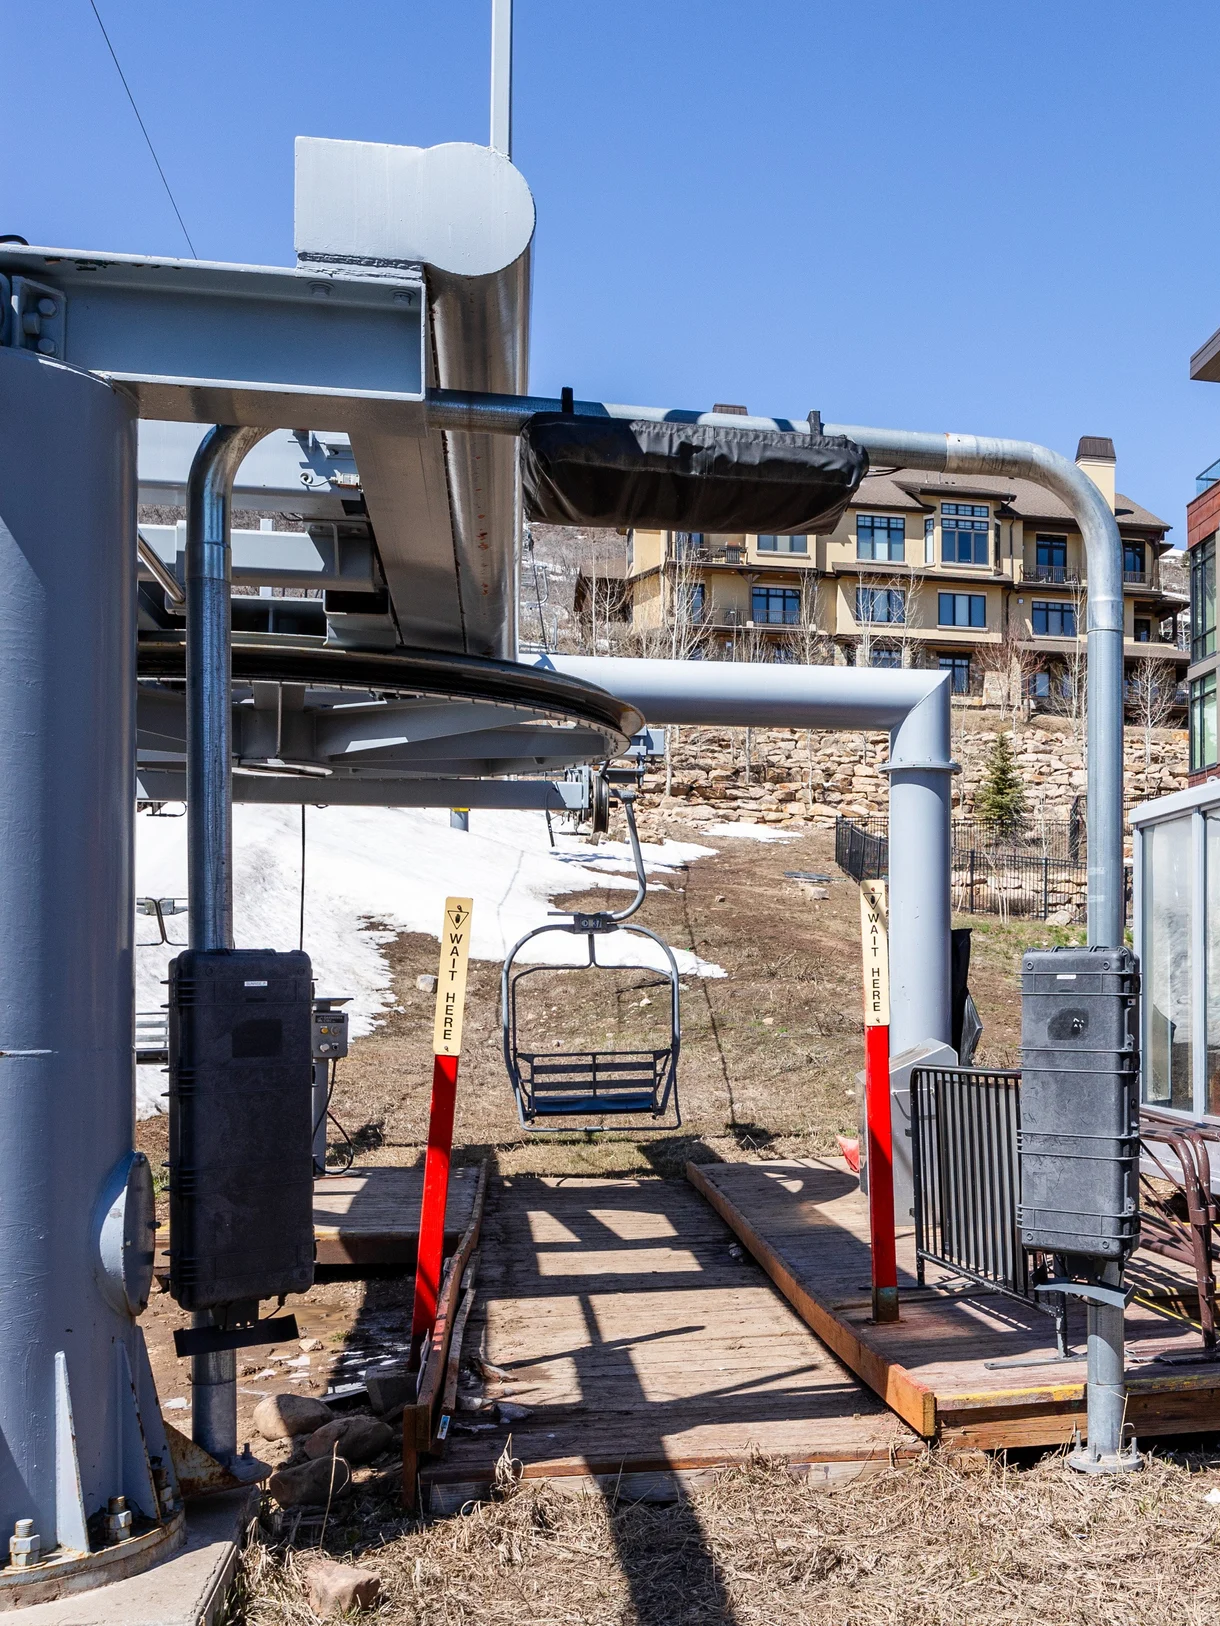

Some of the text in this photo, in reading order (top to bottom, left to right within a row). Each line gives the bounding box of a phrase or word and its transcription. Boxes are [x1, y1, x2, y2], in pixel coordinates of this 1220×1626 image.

[443, 933, 463, 1041] WAIT HERE
[867, 913, 881, 1012] WAIT HERE
